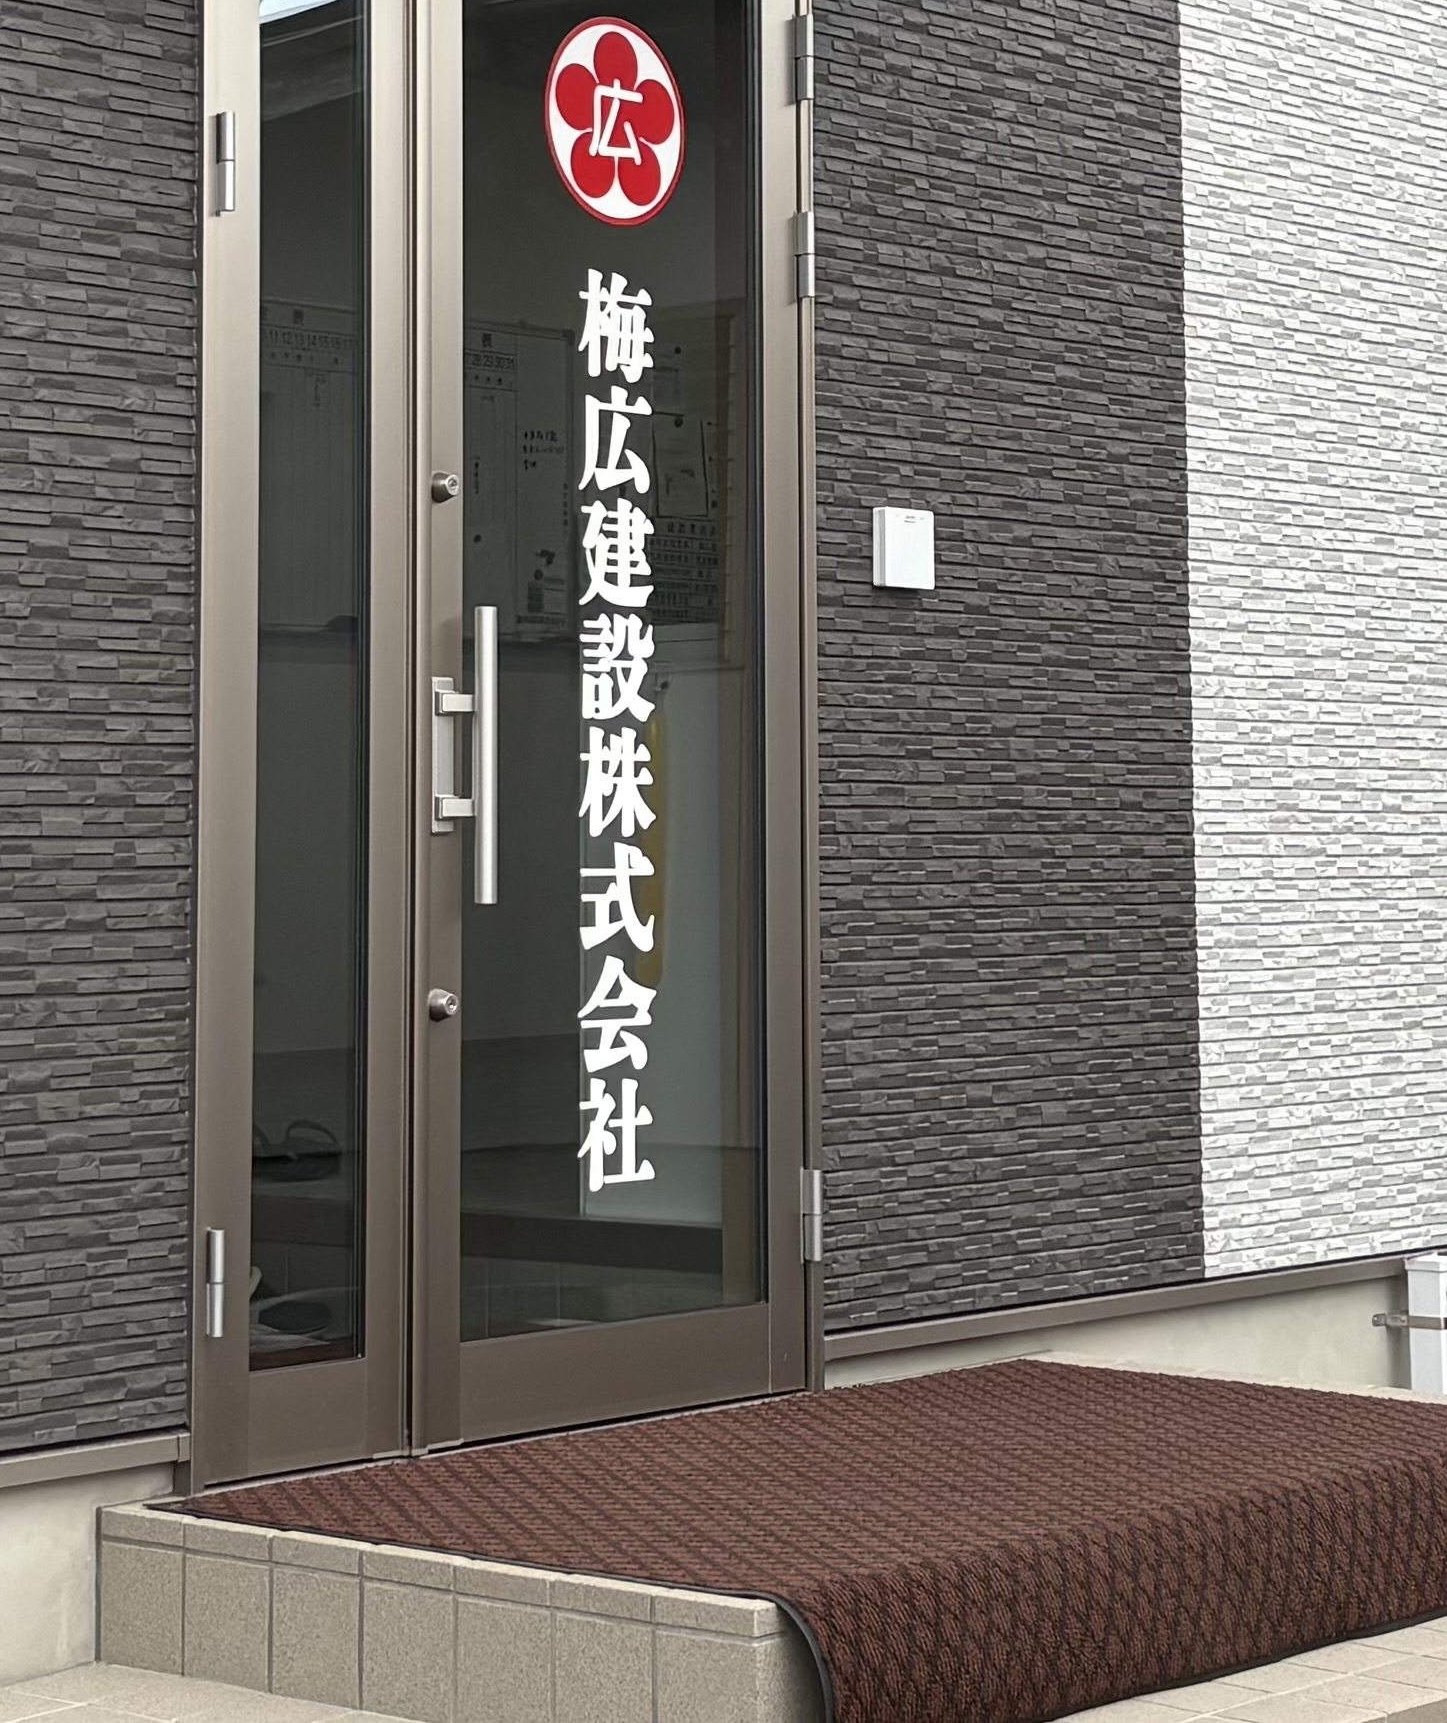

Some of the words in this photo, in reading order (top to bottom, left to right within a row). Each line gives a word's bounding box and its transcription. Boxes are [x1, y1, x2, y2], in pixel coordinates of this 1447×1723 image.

[589, 78, 643, 166] 広
[577, 268, 656, 1193] 梅広建設株式会社
